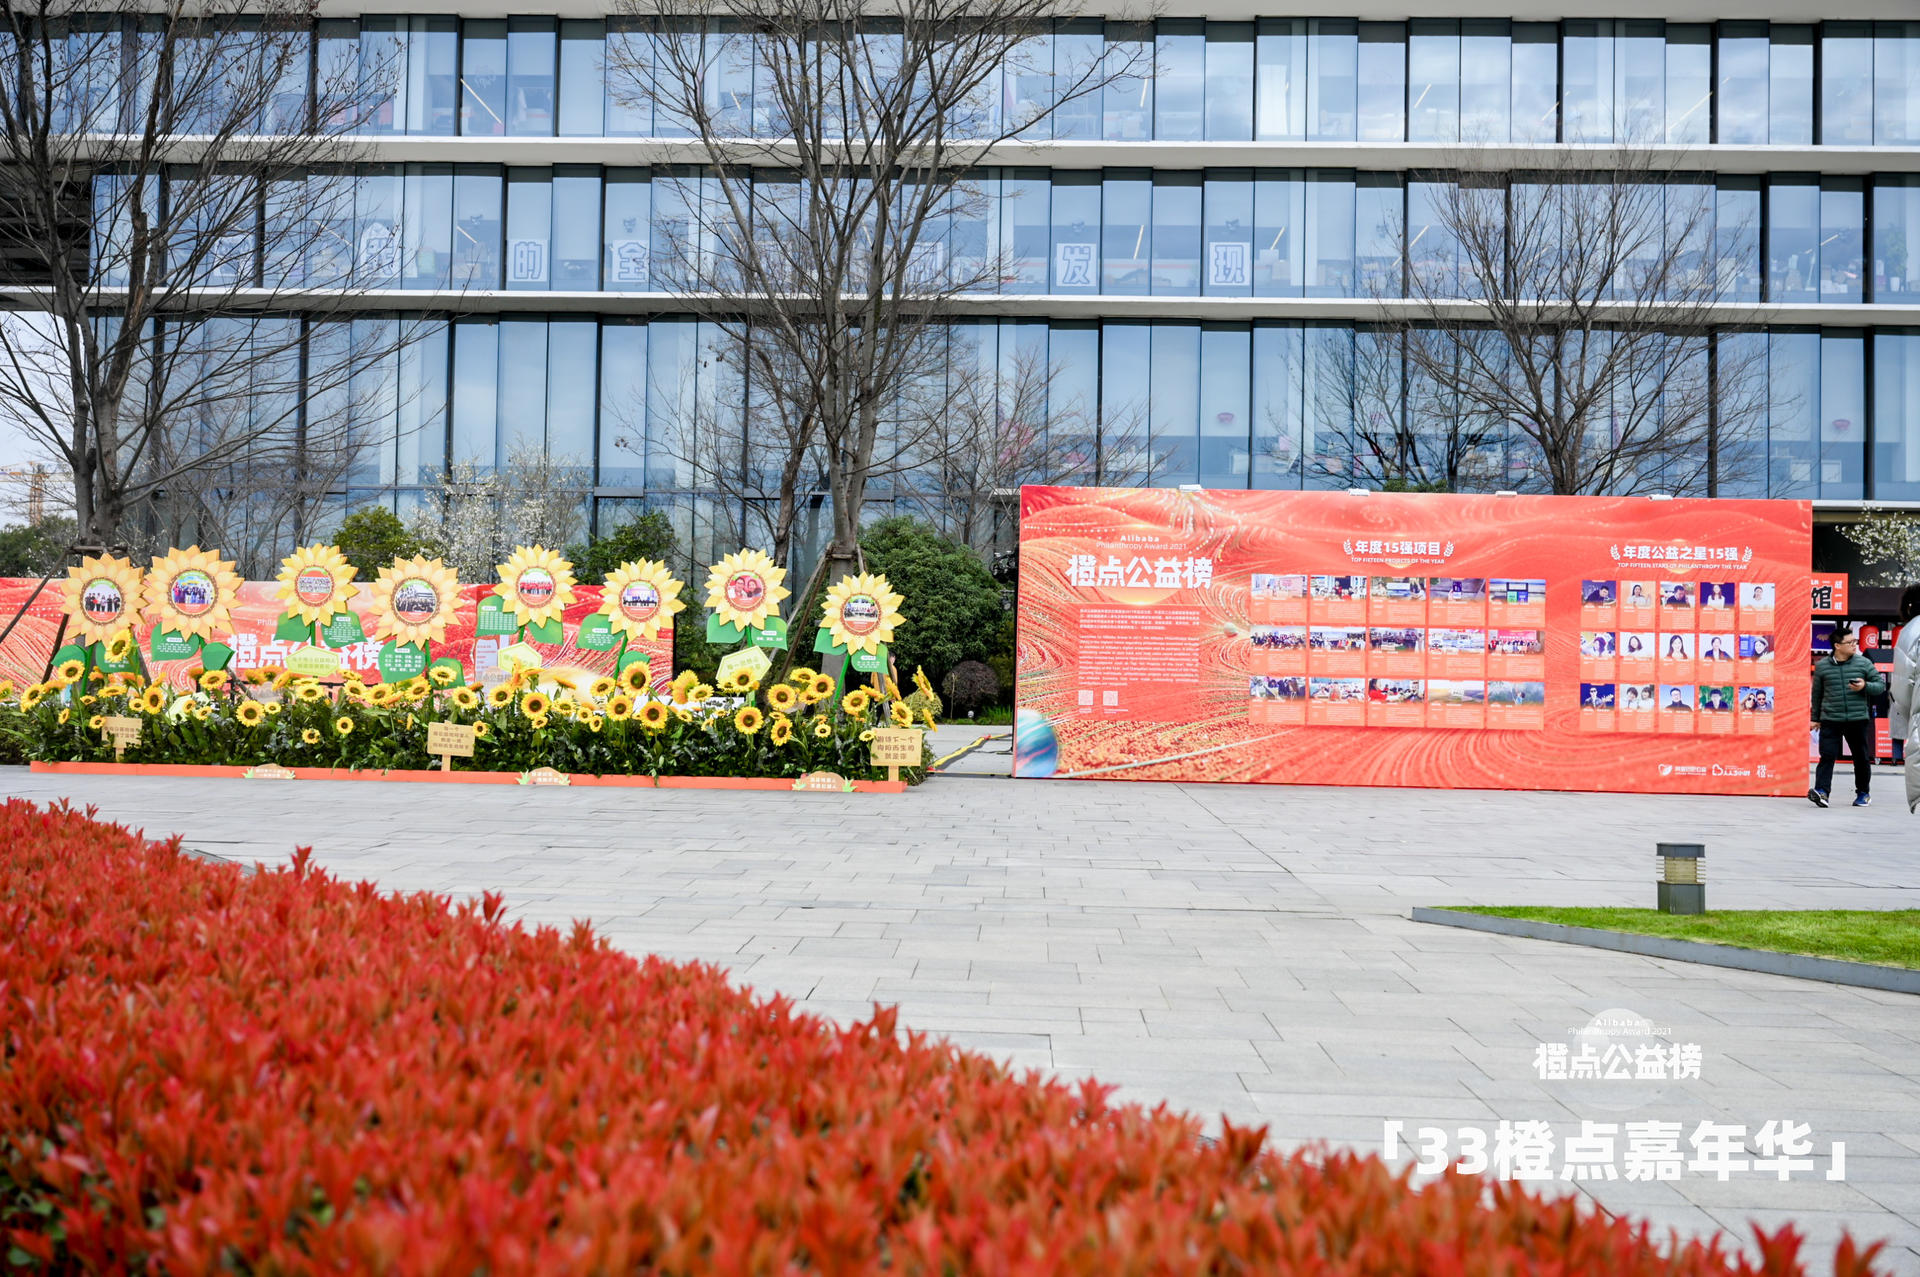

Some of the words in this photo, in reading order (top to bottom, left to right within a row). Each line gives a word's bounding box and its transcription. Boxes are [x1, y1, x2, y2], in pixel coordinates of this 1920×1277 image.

[513, 242, 542, 279] 的
[1062, 246, 1090, 284] 发
[1214, 245, 1244, 283] 现
[1096, 542, 1143, 550] Philanthropy
[1355, 540, 1441, 555] 年度15强项目
[1623, 545, 1738, 560] 年度公益之星15强
[1064, 554, 1213, 589] 橙点公益榜
